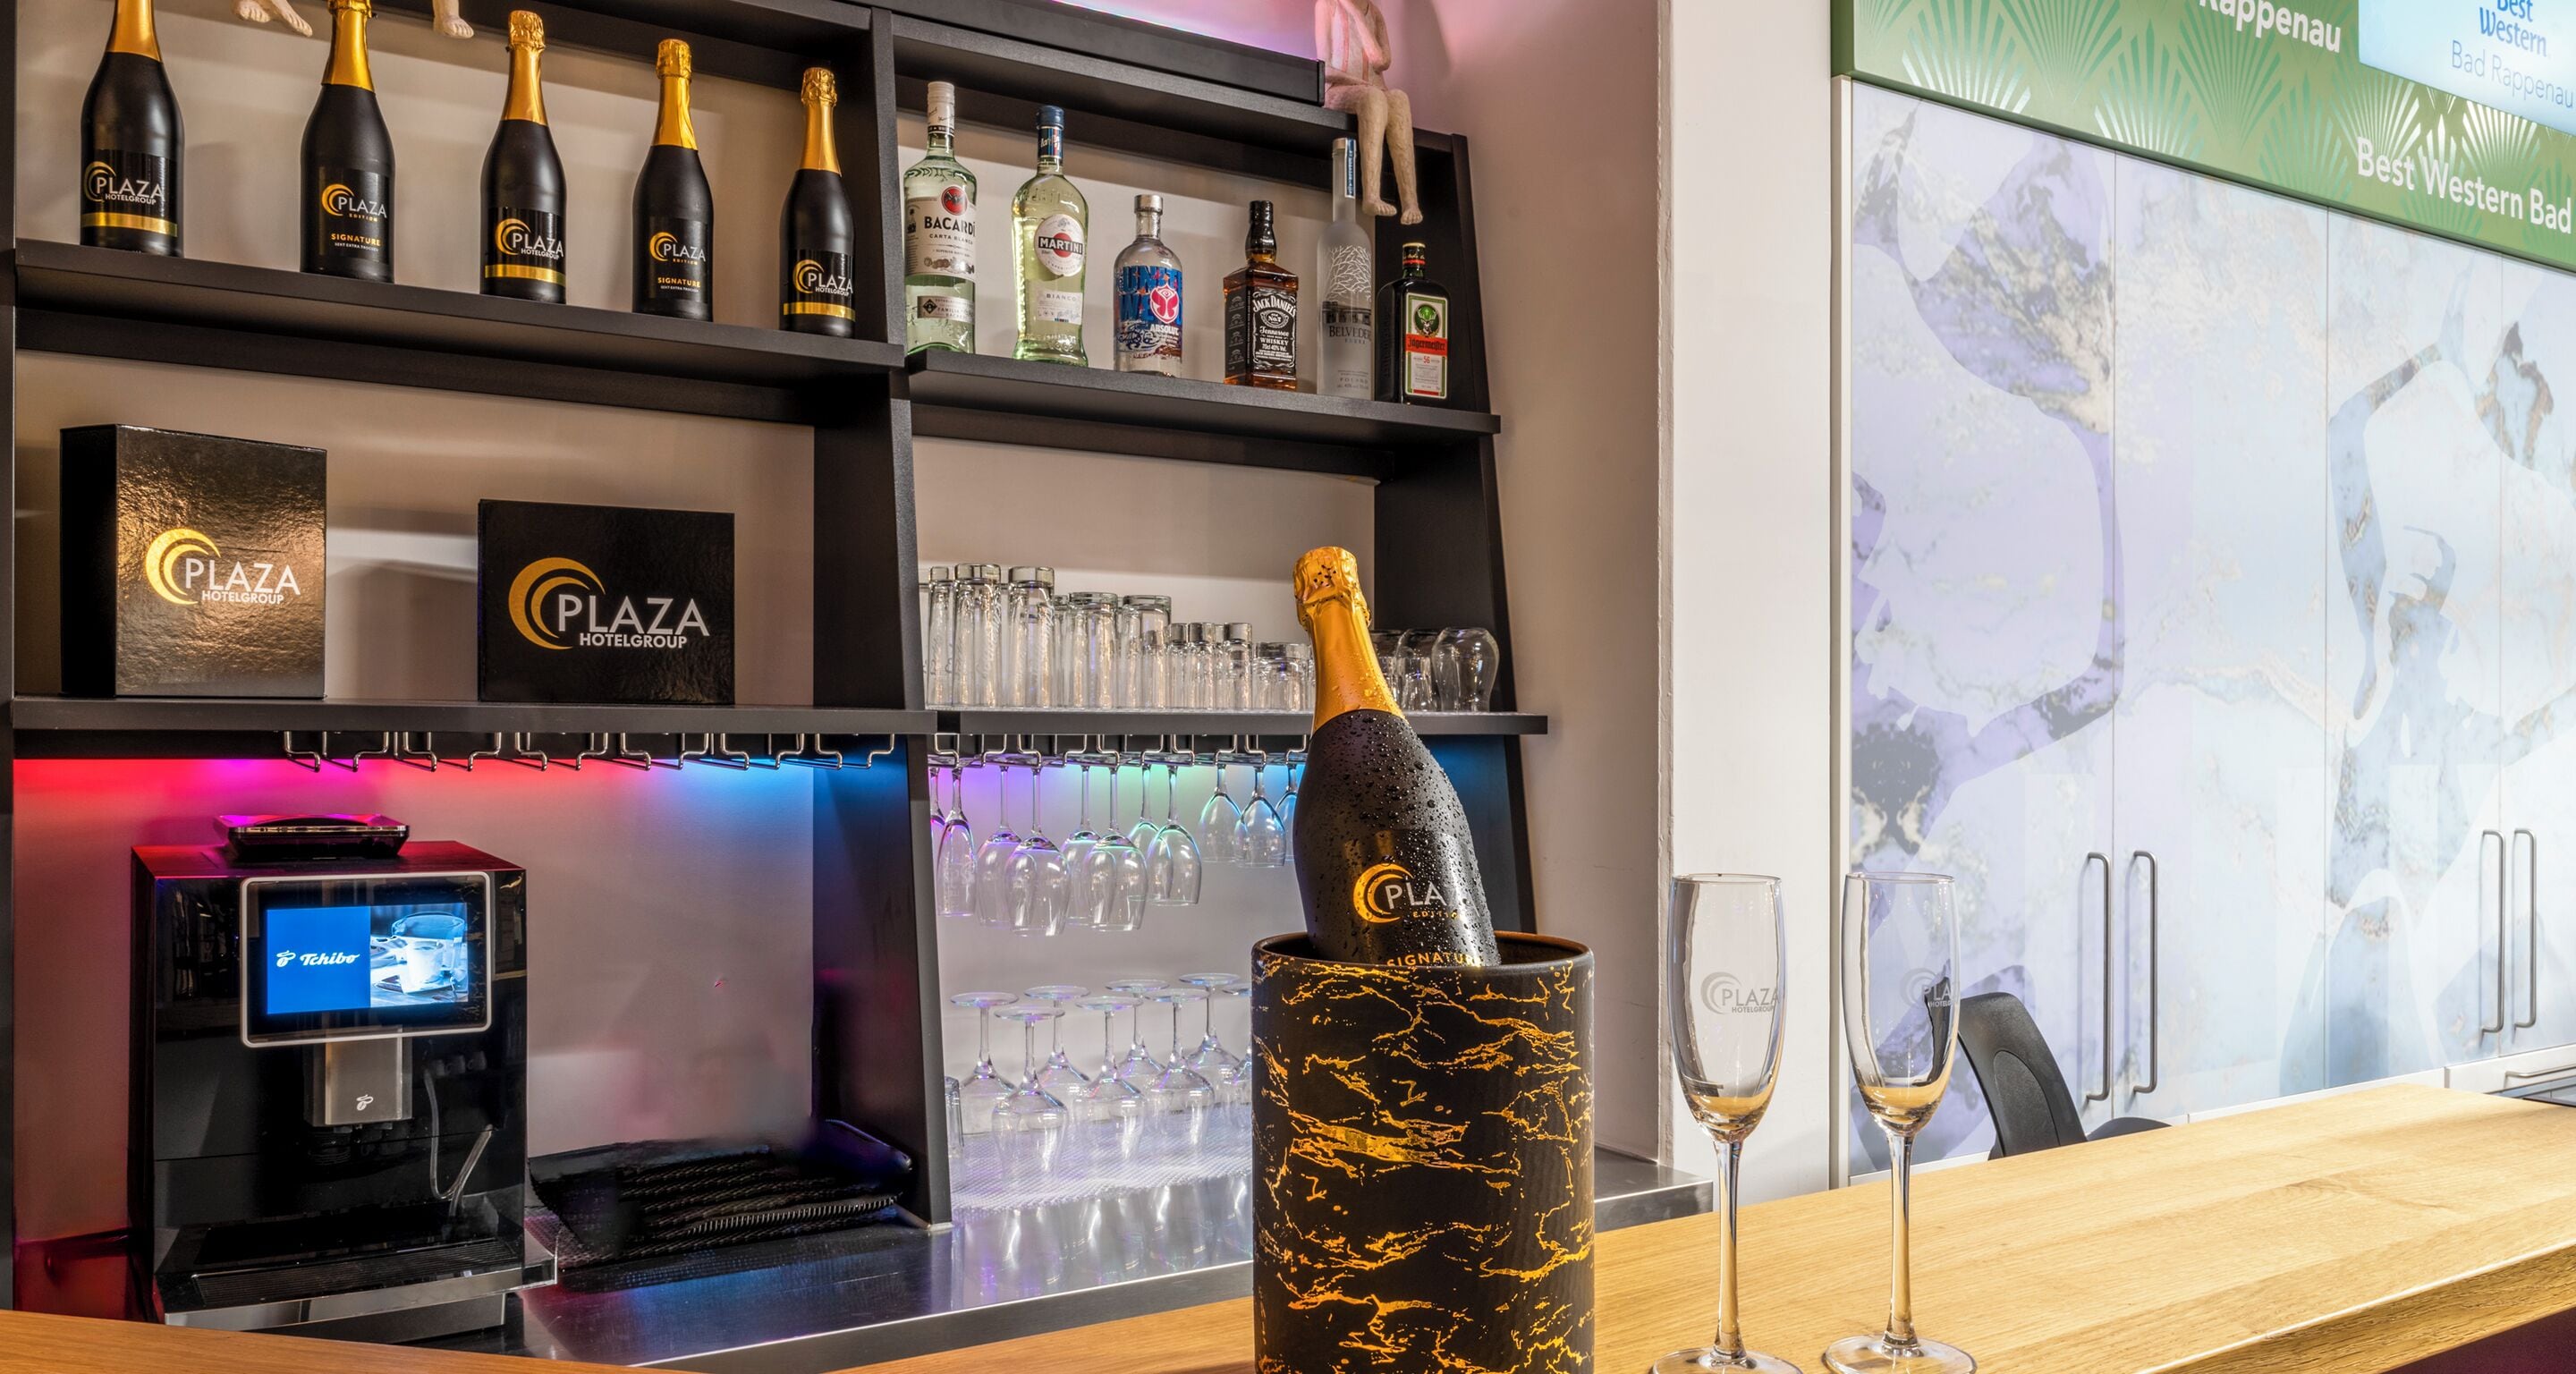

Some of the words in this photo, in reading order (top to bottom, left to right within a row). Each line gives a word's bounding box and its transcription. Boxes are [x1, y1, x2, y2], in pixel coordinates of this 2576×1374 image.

[2479, 6, 2546, 57] Western
[2452, 39, 2485, 78] Bad
[2491, 54, 2573, 108] Rappenau
[96, 177, 165, 199] PLAZA
[2357, 136, 2416, 191] Best
[2421, 156, 2523, 221] Western
[2530, 189, 2572, 234] Bad
[105, 193, 157, 206] HOTELGROUP
[337, 196, 387, 219] PLAZA
[349, 213, 378, 222] EDITION
[331, 233, 381, 247] SIGNATURE
[512, 232, 564, 258] PLAZA
[1039, 238, 1082, 253] MARTINI
[521, 248, 560, 260] HOTELGROUP
[663, 242, 707, 262] PLAZA
[657, 276, 702, 288] SIGNATURE
[808, 272, 854, 294] PLAZA
[815, 286, 850, 297] HOTELGROUP
[1046, 293, 1077, 301] BIANCO
[1252, 298, 1271, 312] JACK
[184, 557, 301, 596] PLAZA
[201, 589, 285, 606] HOTELGROUP
[557, 593, 710, 637] PLAZA
[579, 632, 688, 649] HOTELGROUP
[300, 951, 360, 966] Tchibo
[1721, 988, 1780, 1006] PLAZA
